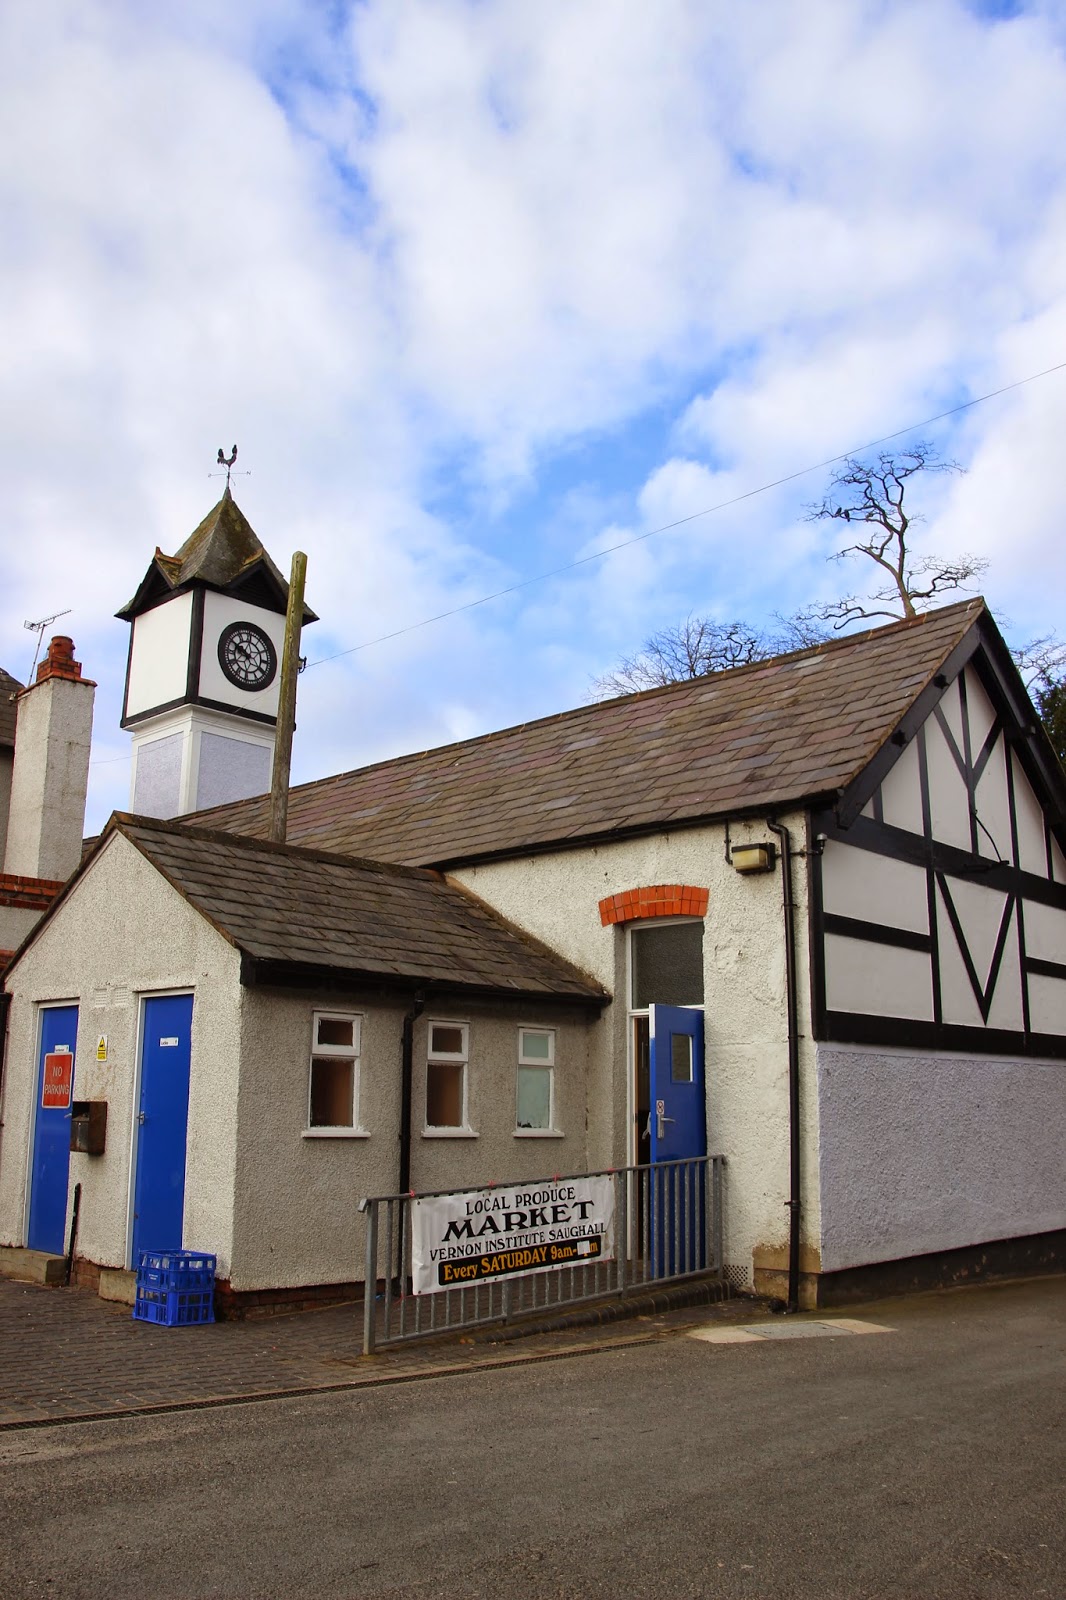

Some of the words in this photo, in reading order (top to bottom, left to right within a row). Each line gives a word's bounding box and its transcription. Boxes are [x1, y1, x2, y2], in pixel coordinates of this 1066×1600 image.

[52, 1066, 63, 1077] NO
[44, 1084, 69, 1095] PARKING
[465, 1196, 511, 1216] LOCAL
[515, 1186, 576, 1208] PRODUCE
[441, 1200, 595, 1242] MARKET
[429, 1242, 482, 1262] VERNON
[485, 1231, 546, 1252] INSTITUTE
[548, 1222, 607, 1242] SAUGHALL
[443, 1264, 478, 1281] Every
[481, 1246, 547, 1274] SATURDAY
[550, 1241, 598, 1258] 9am-m
